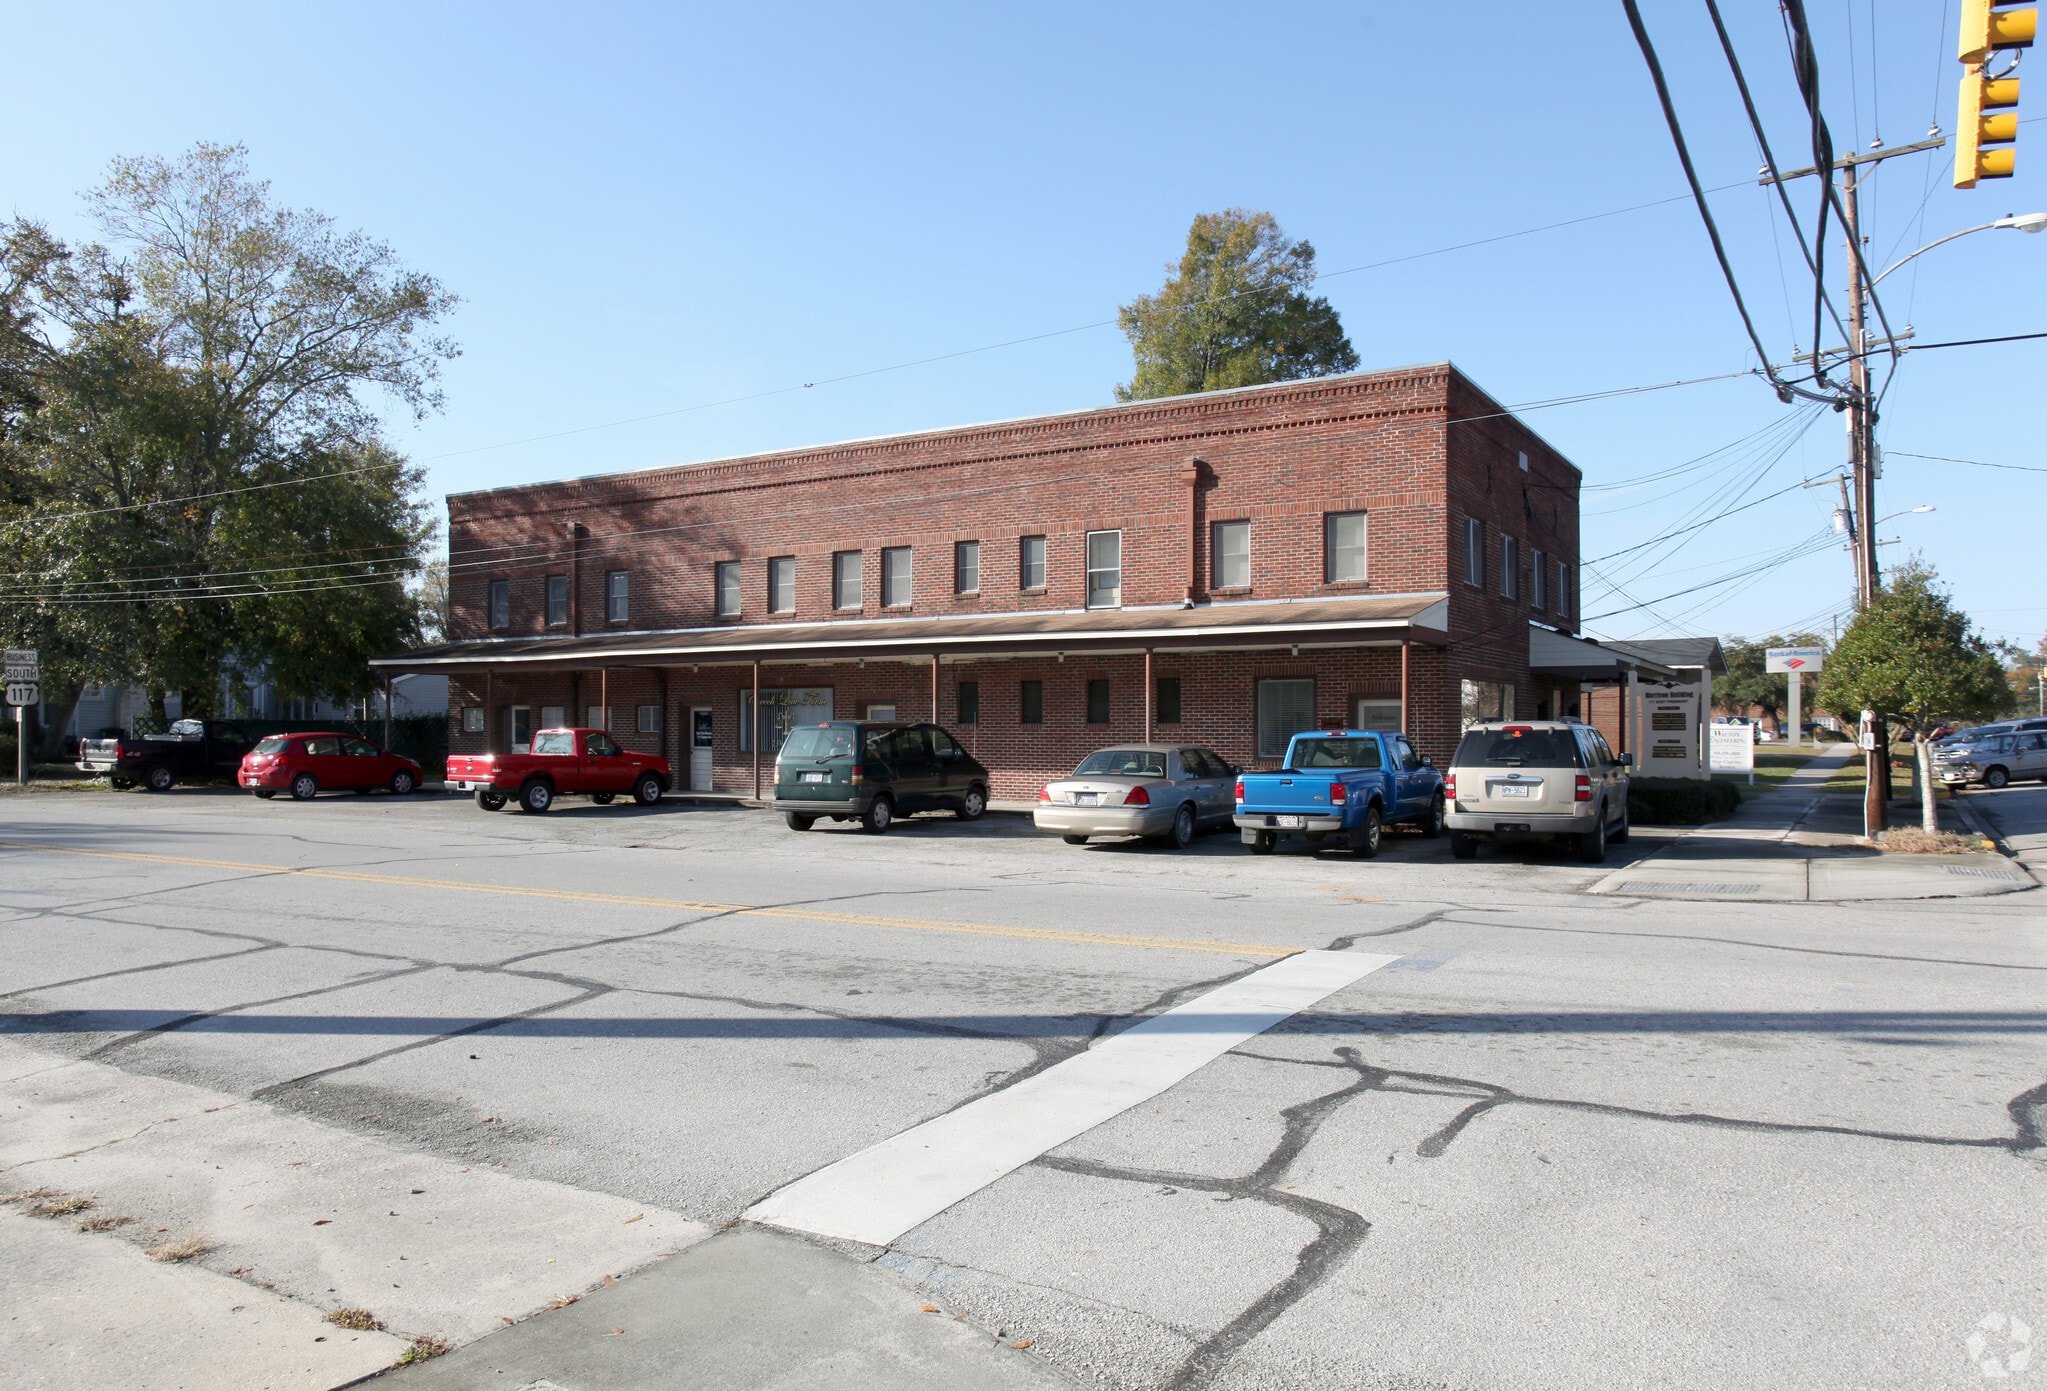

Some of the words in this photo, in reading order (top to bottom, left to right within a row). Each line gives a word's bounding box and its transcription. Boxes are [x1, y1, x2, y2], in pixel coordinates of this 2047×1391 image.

[6, 652, 36, 662] BUSINESS
[6, 668, 37, 678] SOUTH
[12, 688, 34, 701] 117
